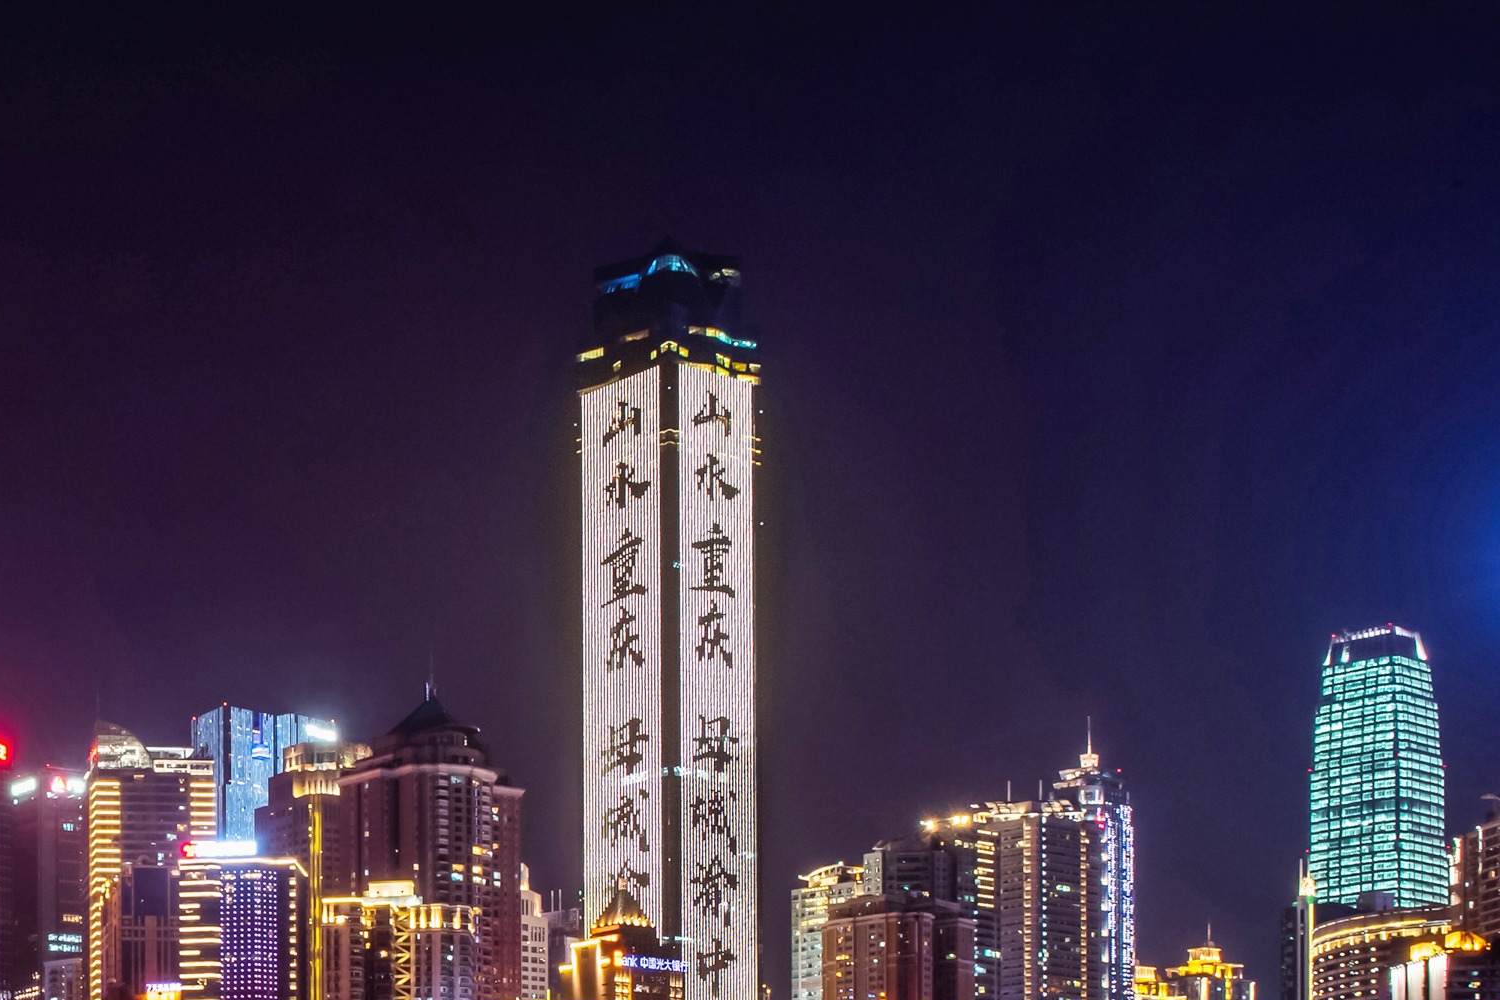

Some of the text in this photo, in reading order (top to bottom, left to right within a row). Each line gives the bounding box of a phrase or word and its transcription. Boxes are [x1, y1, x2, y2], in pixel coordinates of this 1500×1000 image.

[601, 401, 651, 674] 山水重庆
[689, 390, 741, 669] 山水重庆
[640, 957, 689, 972] 中国光大银行
